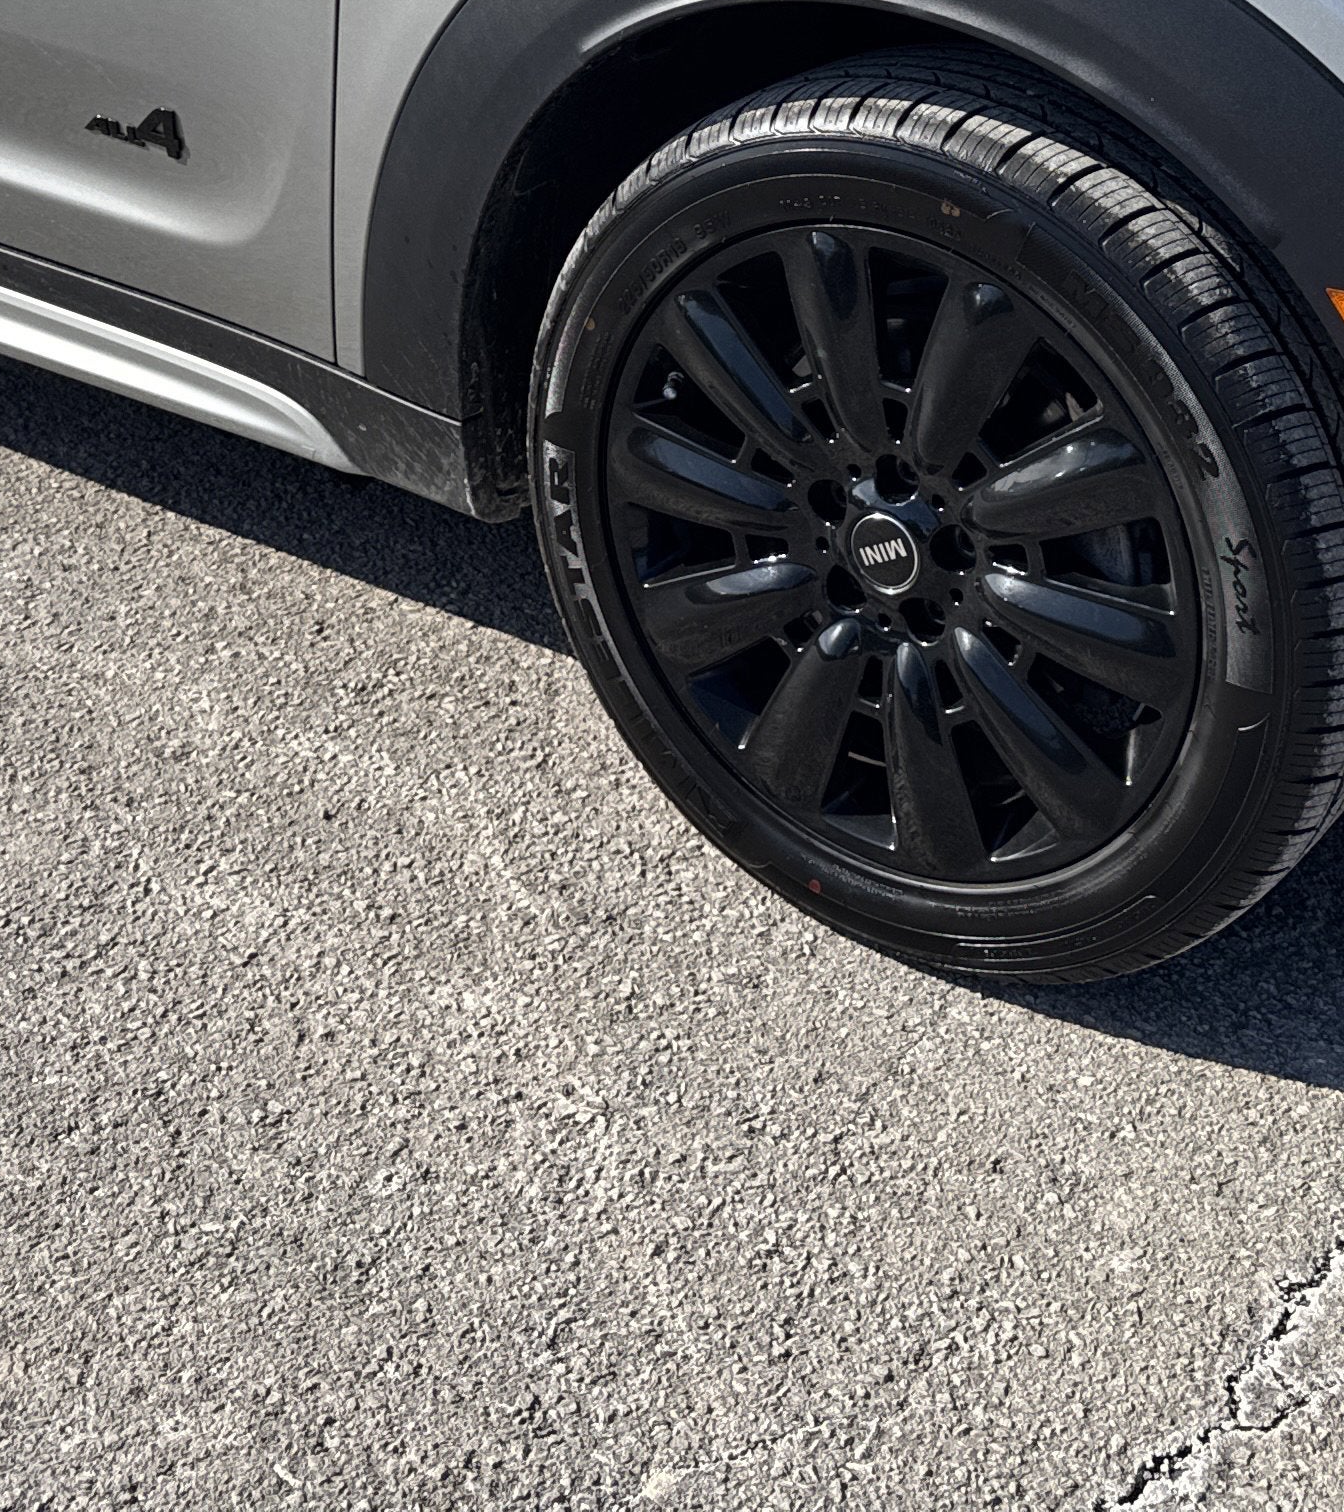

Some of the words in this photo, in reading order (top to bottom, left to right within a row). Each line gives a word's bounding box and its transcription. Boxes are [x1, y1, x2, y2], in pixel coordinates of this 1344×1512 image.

[84, 107, 183, 160] ALL4
[859, 538, 908, 566] MINI
[1219, 536, 1261, 637] Sport
